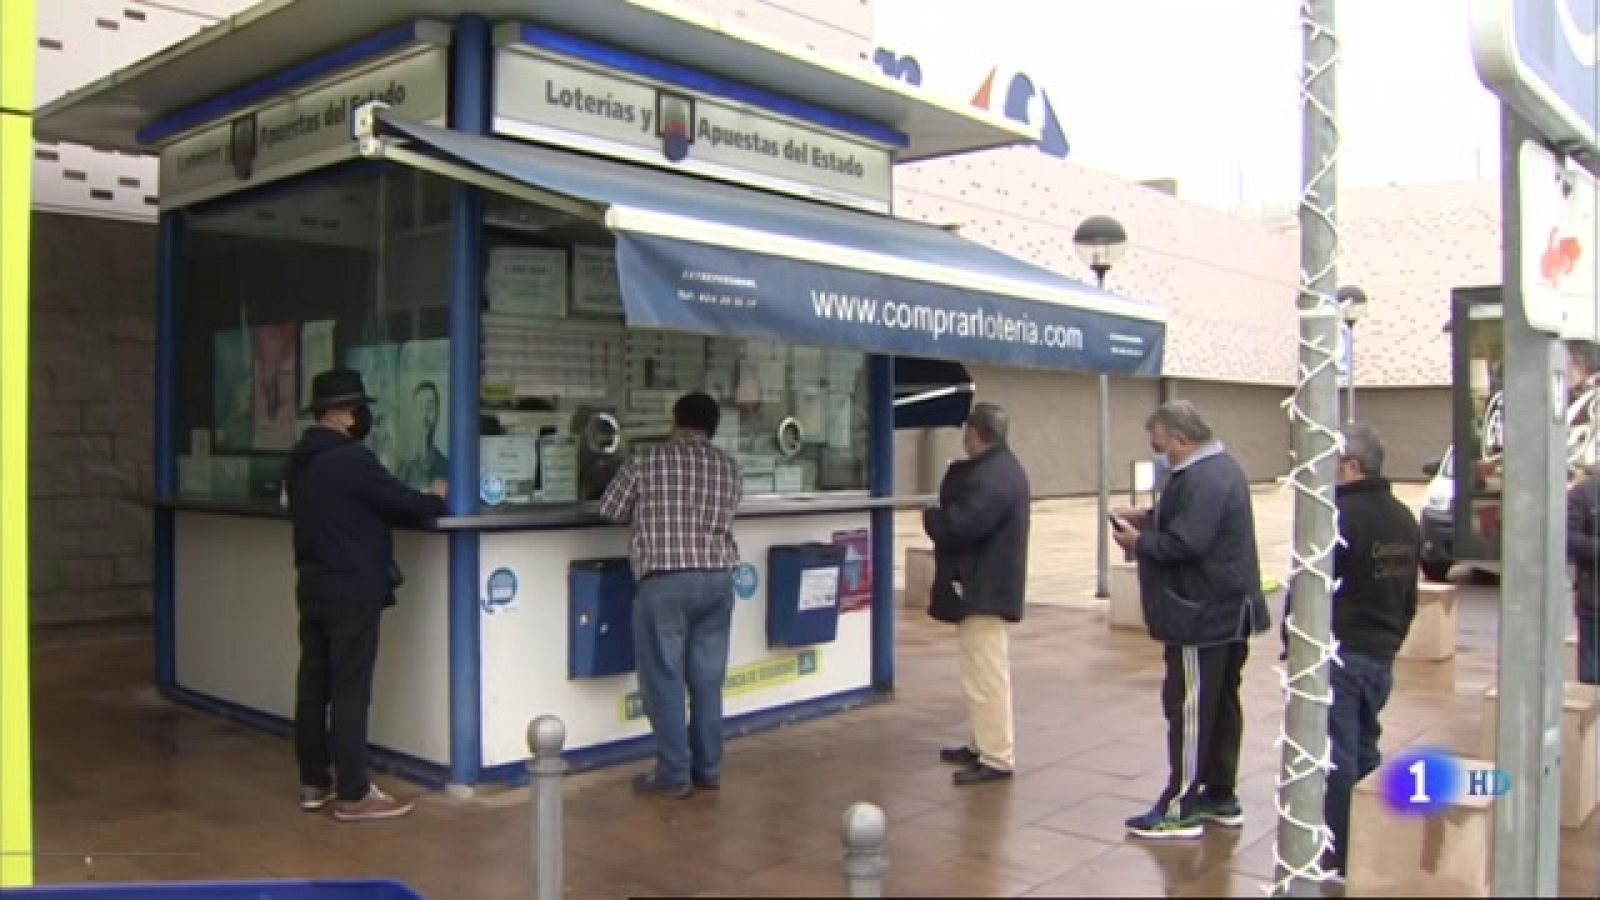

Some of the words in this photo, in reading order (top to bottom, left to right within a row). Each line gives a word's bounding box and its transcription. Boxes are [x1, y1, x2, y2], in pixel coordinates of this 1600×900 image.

[325, 99, 346, 126] del
[545, 79, 635, 123] Loterías
[640, 107, 652, 132] y
[698, 117, 778, 157] Apuestas
[784, 137, 808, 164] del
[812, 146, 864, 178] Estado
[810, 289, 1083, 350] www.comprarloteria.com
